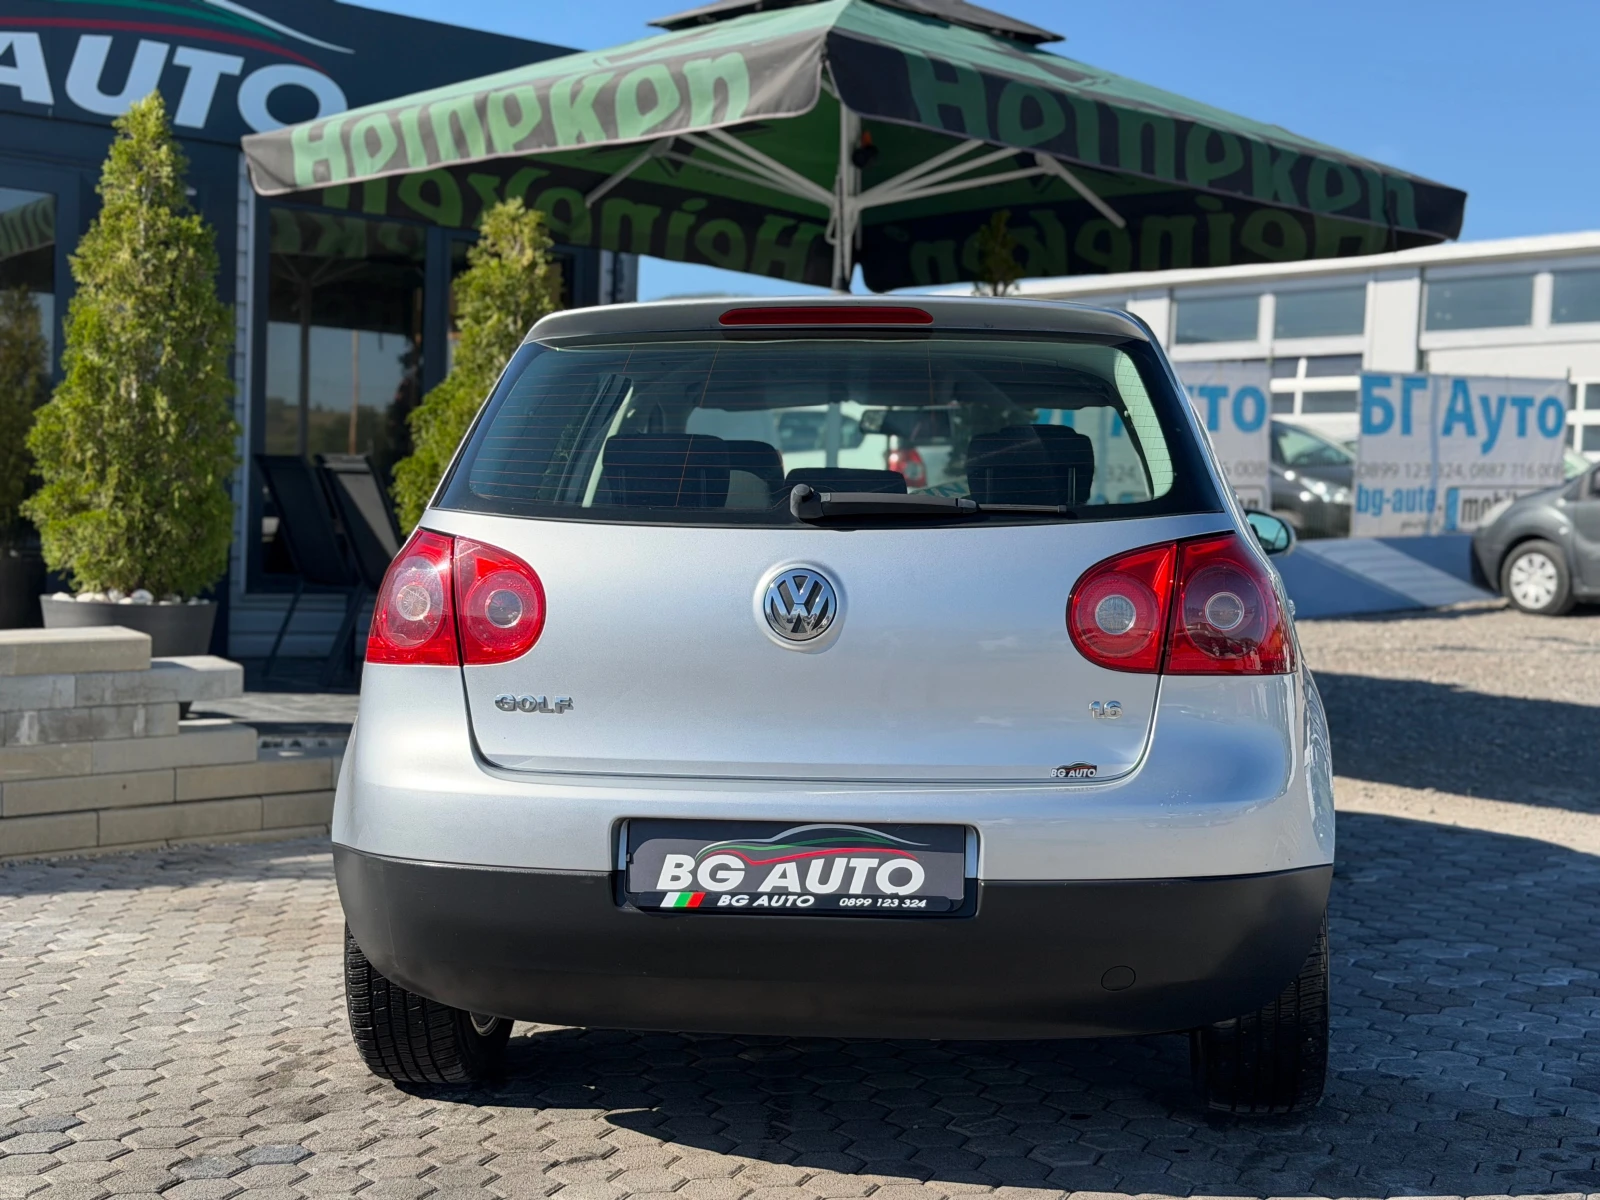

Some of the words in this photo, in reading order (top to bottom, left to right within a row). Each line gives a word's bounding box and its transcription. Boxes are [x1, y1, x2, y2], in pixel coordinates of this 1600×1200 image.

[0, 31, 348, 135] AUTO
[1360, 374, 1428, 436] БГ
[1441, 377, 1566, 456] Ауто
[765, 569, 837, 641] VW
[494, 693, 574, 714] GOLF
[1051, 768, 1066, 777] BG
[1068, 768, 1096, 778] AUTO
[656, 854, 747, 891] BG
[759, 857, 925, 895] AUTO
[717, 894, 749, 907] BG
[756, 895, 815, 907] AUTO
[839, 898, 873, 907] 0899
[876, 898, 900, 908] 123
[902, 899, 927, 908] 324
